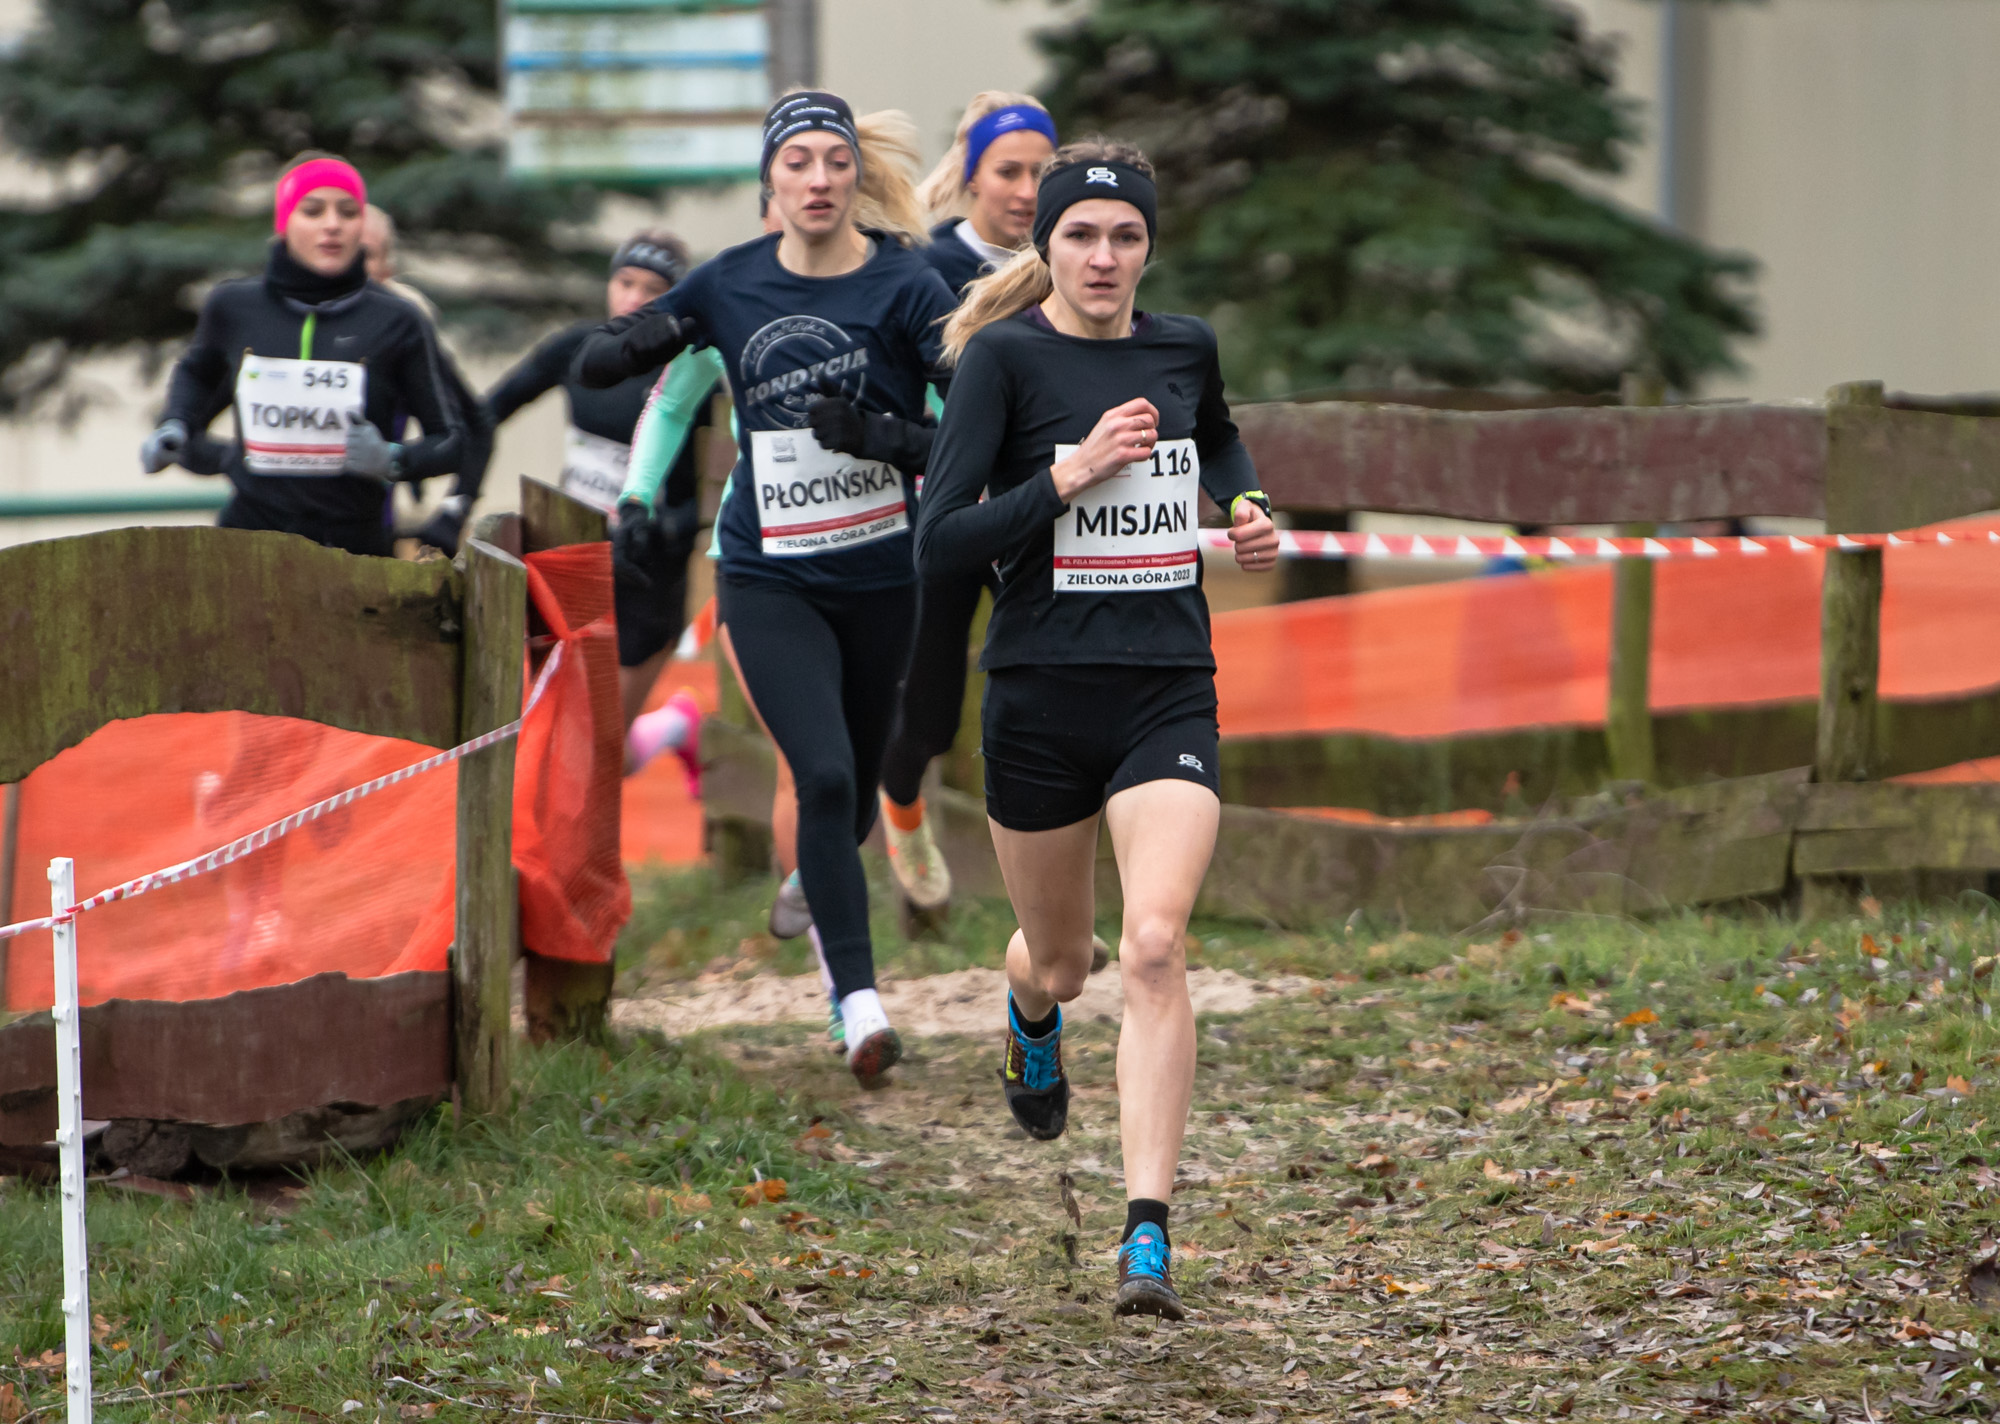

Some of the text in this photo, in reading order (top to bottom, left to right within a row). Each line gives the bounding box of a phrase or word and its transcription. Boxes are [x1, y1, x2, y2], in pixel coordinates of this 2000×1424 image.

[303, 367, 349, 389] 545
[250, 402, 342, 430] TOPKA
[1150, 447, 1192, 477] 116
[762, 463, 897, 510] PŁOCIŃSKA
[1076, 500, 1188, 537] MISJAN
[776, 536, 828, 549] ZIELONA
[830, 527, 870, 543] GÓRA
[868, 518, 896, 534] 2023
[1088, 557, 1126, 566] Mistrzostwa
[1126, 557, 1144, 565] Polski
[1067, 568, 1190, 585] ZIELONA GÓRA 2023
